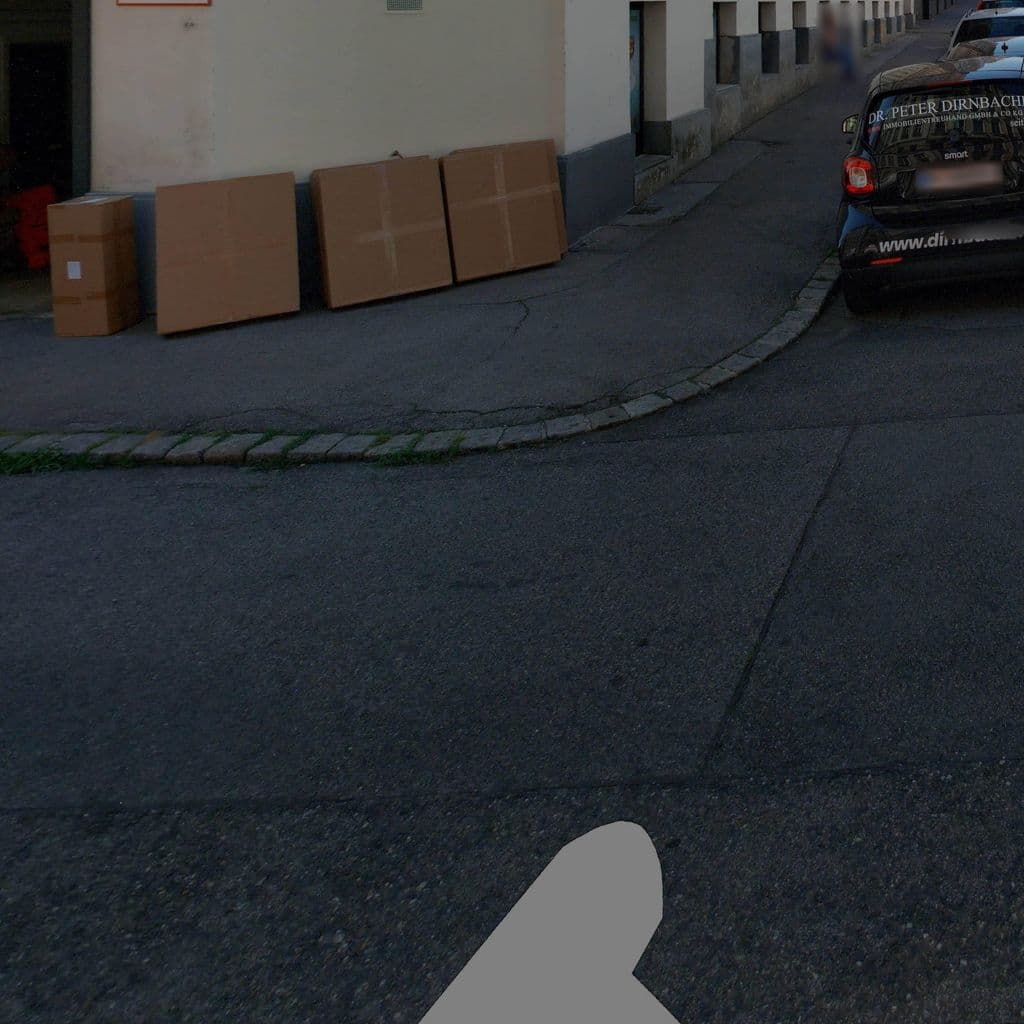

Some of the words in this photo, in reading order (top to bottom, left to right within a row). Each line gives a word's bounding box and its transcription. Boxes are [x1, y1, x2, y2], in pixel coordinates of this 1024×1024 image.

[868, 110, 888, 124] DR.
[892, 102, 938, 119] PETER
[944, 150, 969, 160] smart
